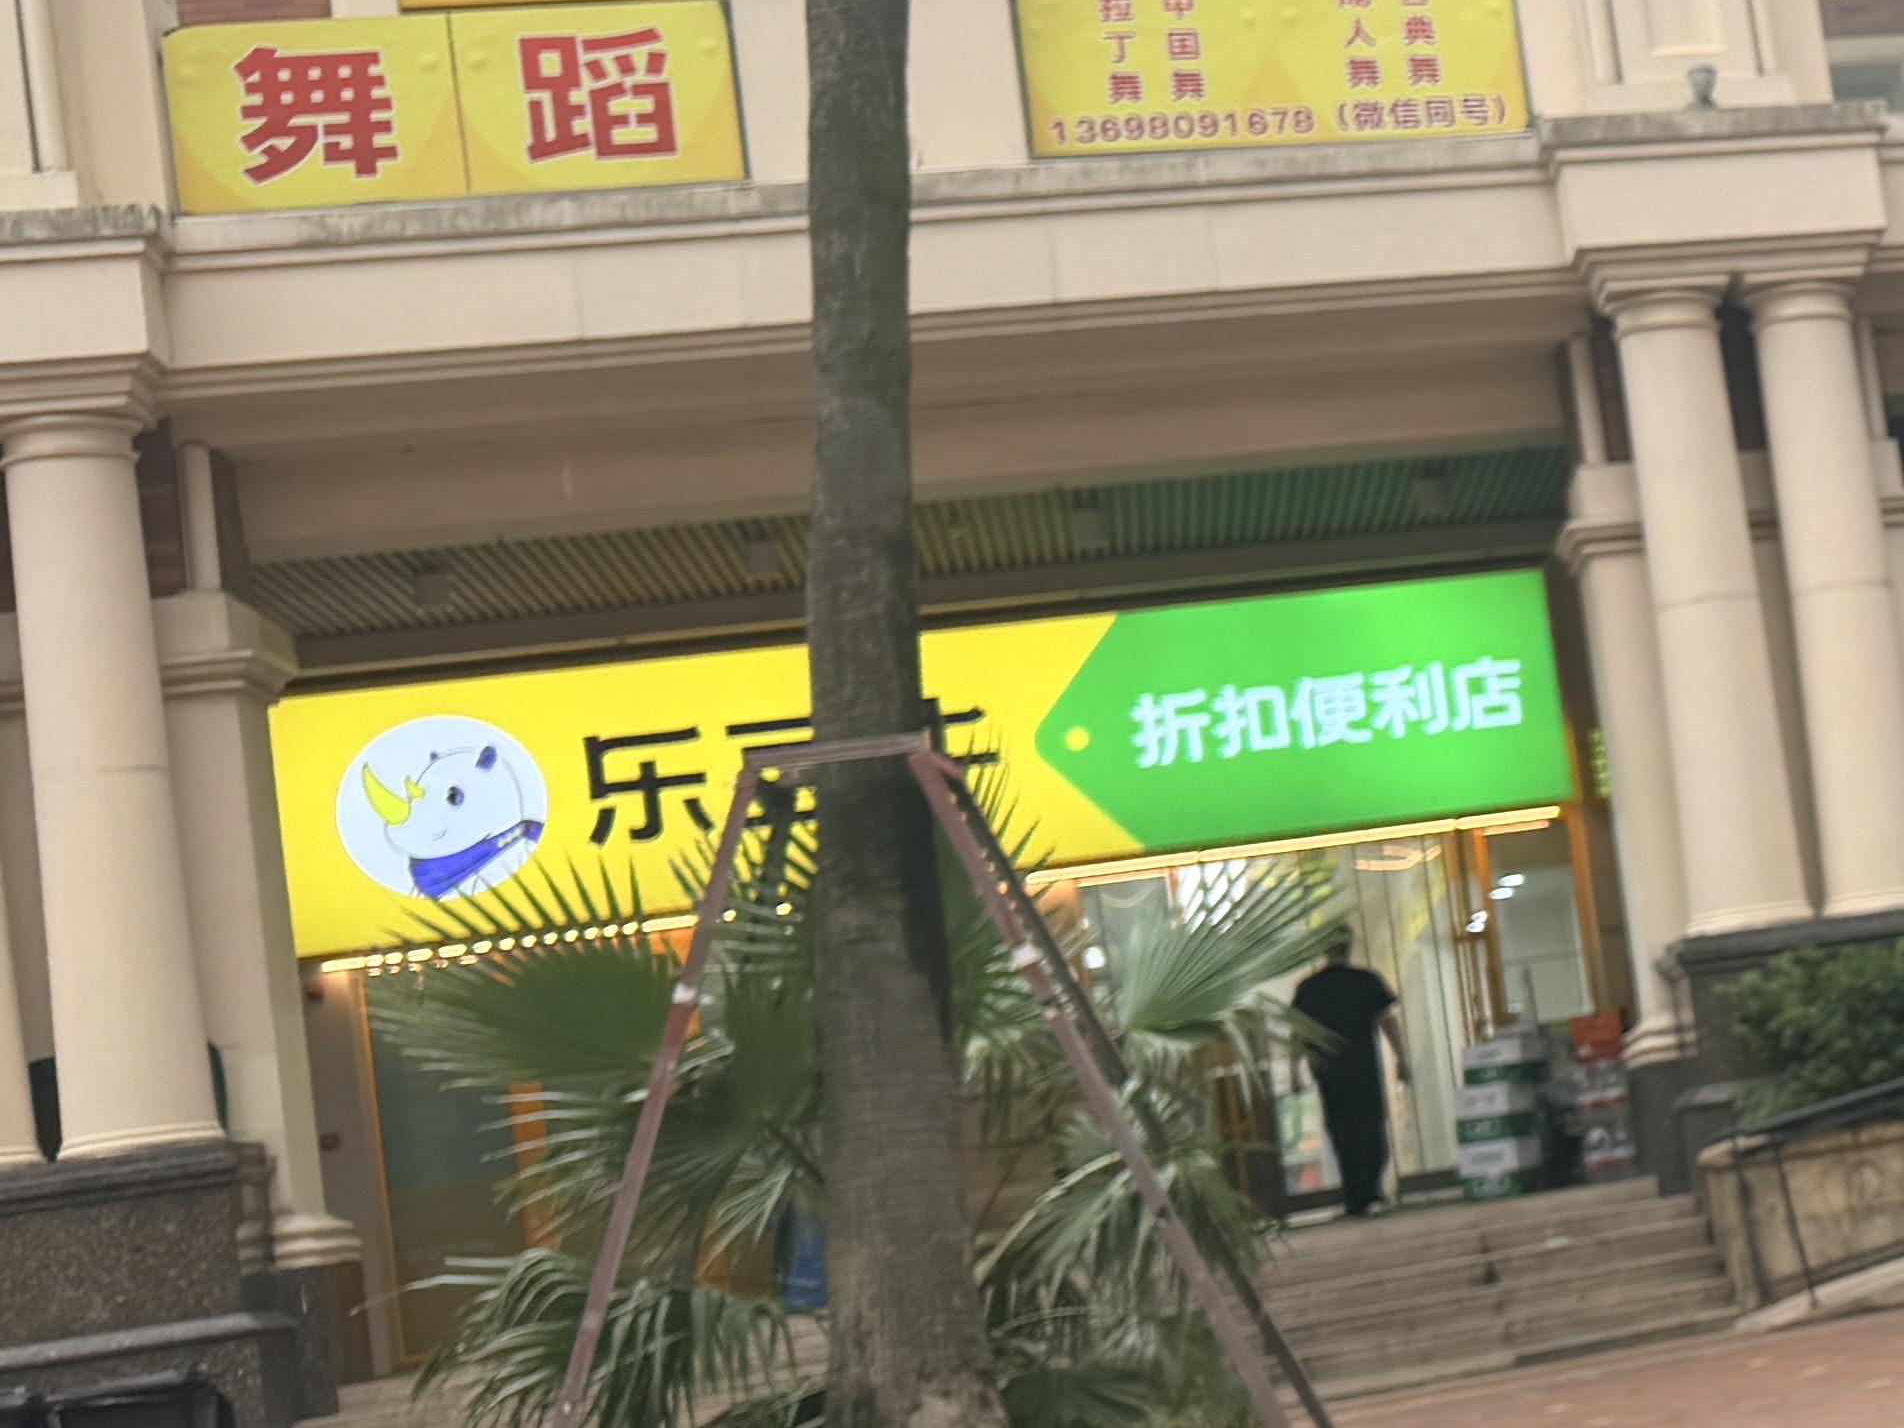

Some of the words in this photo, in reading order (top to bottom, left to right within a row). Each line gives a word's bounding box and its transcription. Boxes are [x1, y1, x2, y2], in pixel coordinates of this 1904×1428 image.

[233, 23, 680, 185] 舞蹈
[1050, 105, 1315, 145] 13698091678
[1131, 656, 1523, 769] 折扣便利店
